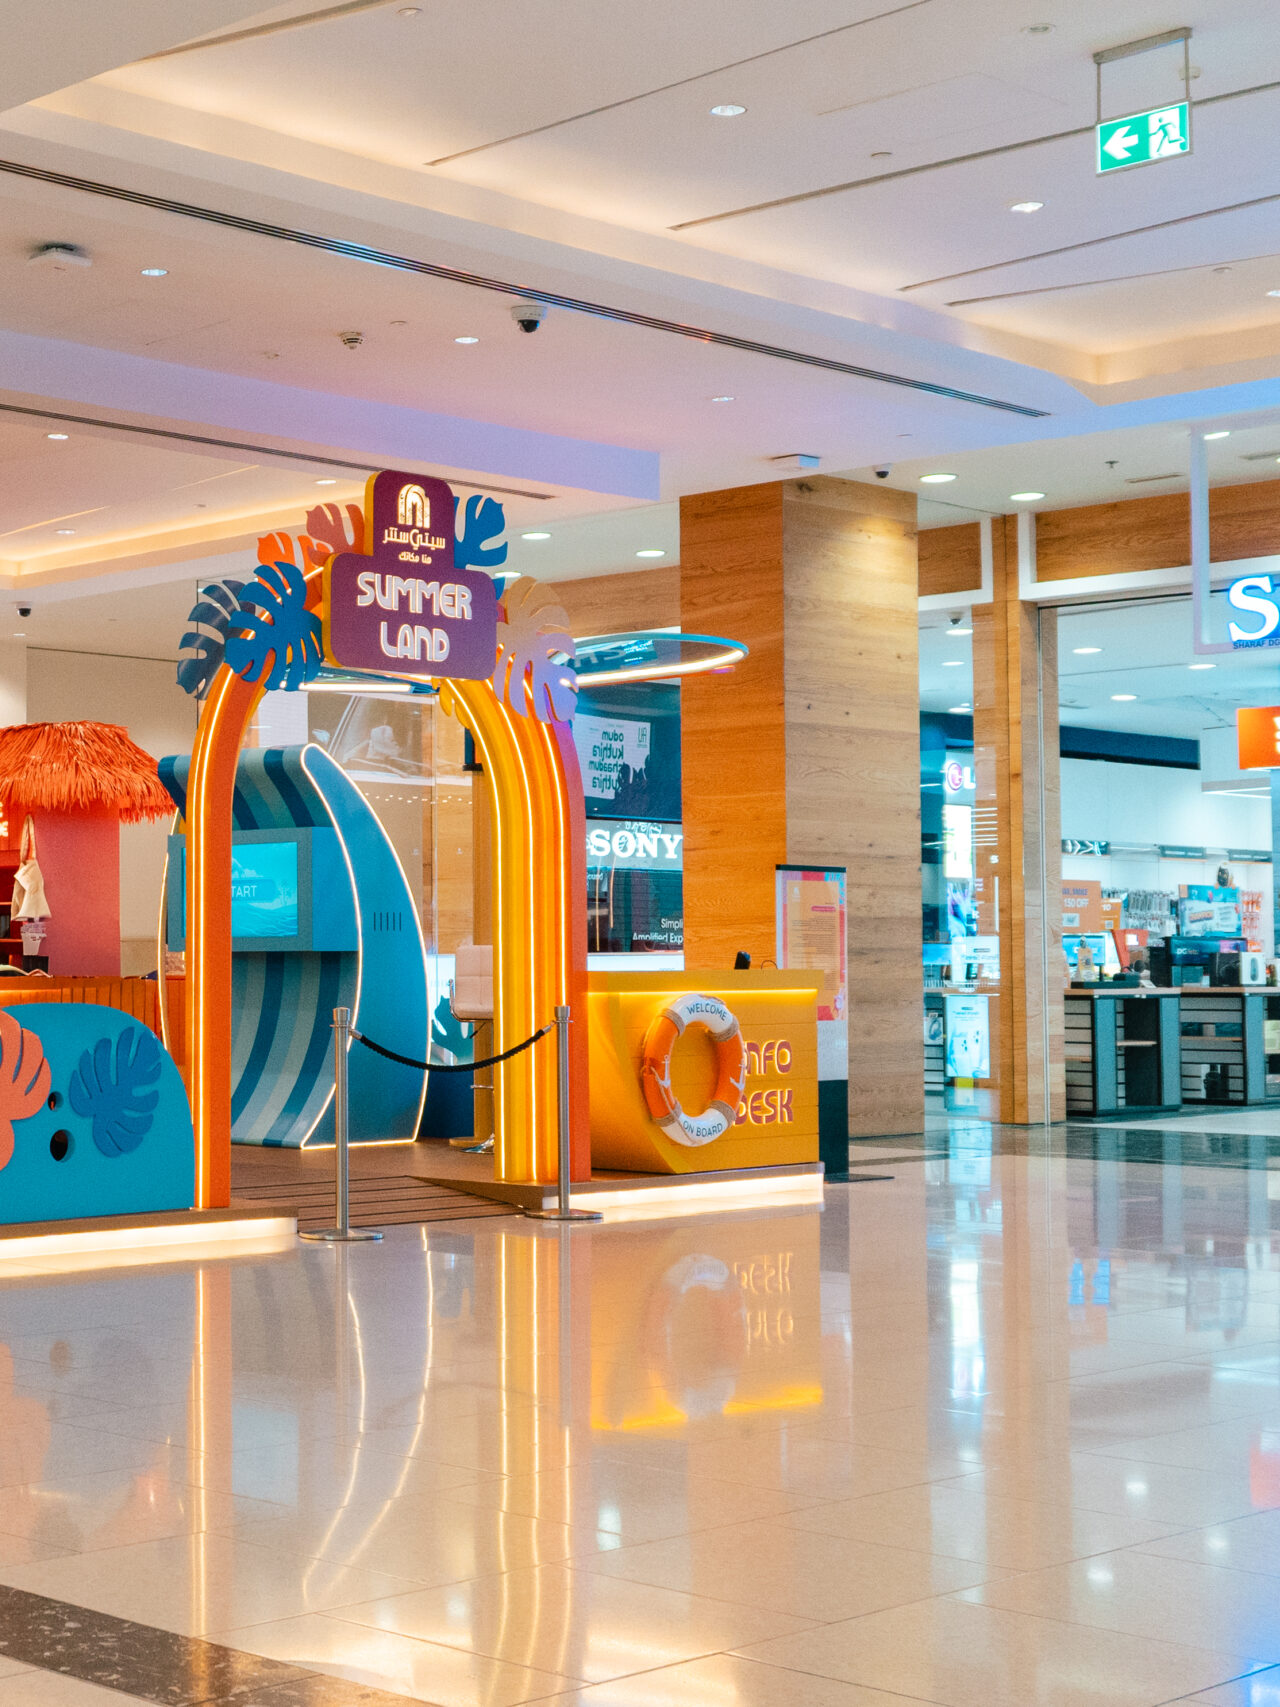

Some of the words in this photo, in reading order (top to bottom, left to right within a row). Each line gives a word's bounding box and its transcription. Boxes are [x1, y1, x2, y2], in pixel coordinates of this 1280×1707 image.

[357, 571, 472, 620] SUMMER
[380, 621, 450, 662] LAND
[1233, 640, 1266, 650] SHARAF
[589, 829, 683, 859] SONY
[231, 885, 258, 898] TART
[686, 1002, 728, 1021] WELCOME
[744, 1040, 793, 1075] NFO
[683, 1121, 694, 1134] ON
[695, 1122, 723, 1137] BOARD
